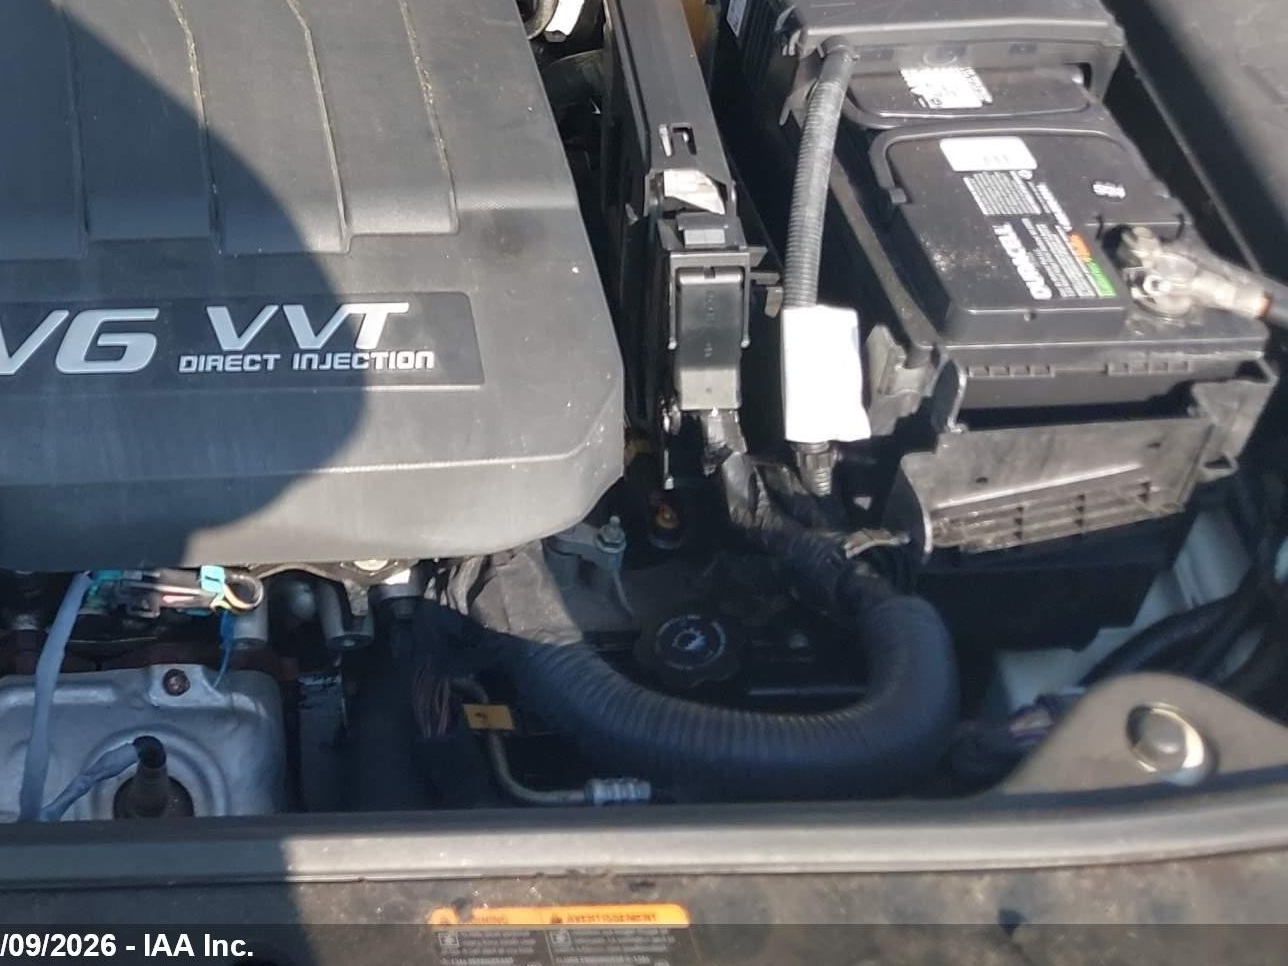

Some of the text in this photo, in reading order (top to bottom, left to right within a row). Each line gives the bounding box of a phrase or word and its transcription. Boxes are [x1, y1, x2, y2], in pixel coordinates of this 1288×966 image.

[206, 301, 410, 351] VVT
[177, 350, 435, 372] DIRECT INJECTION
